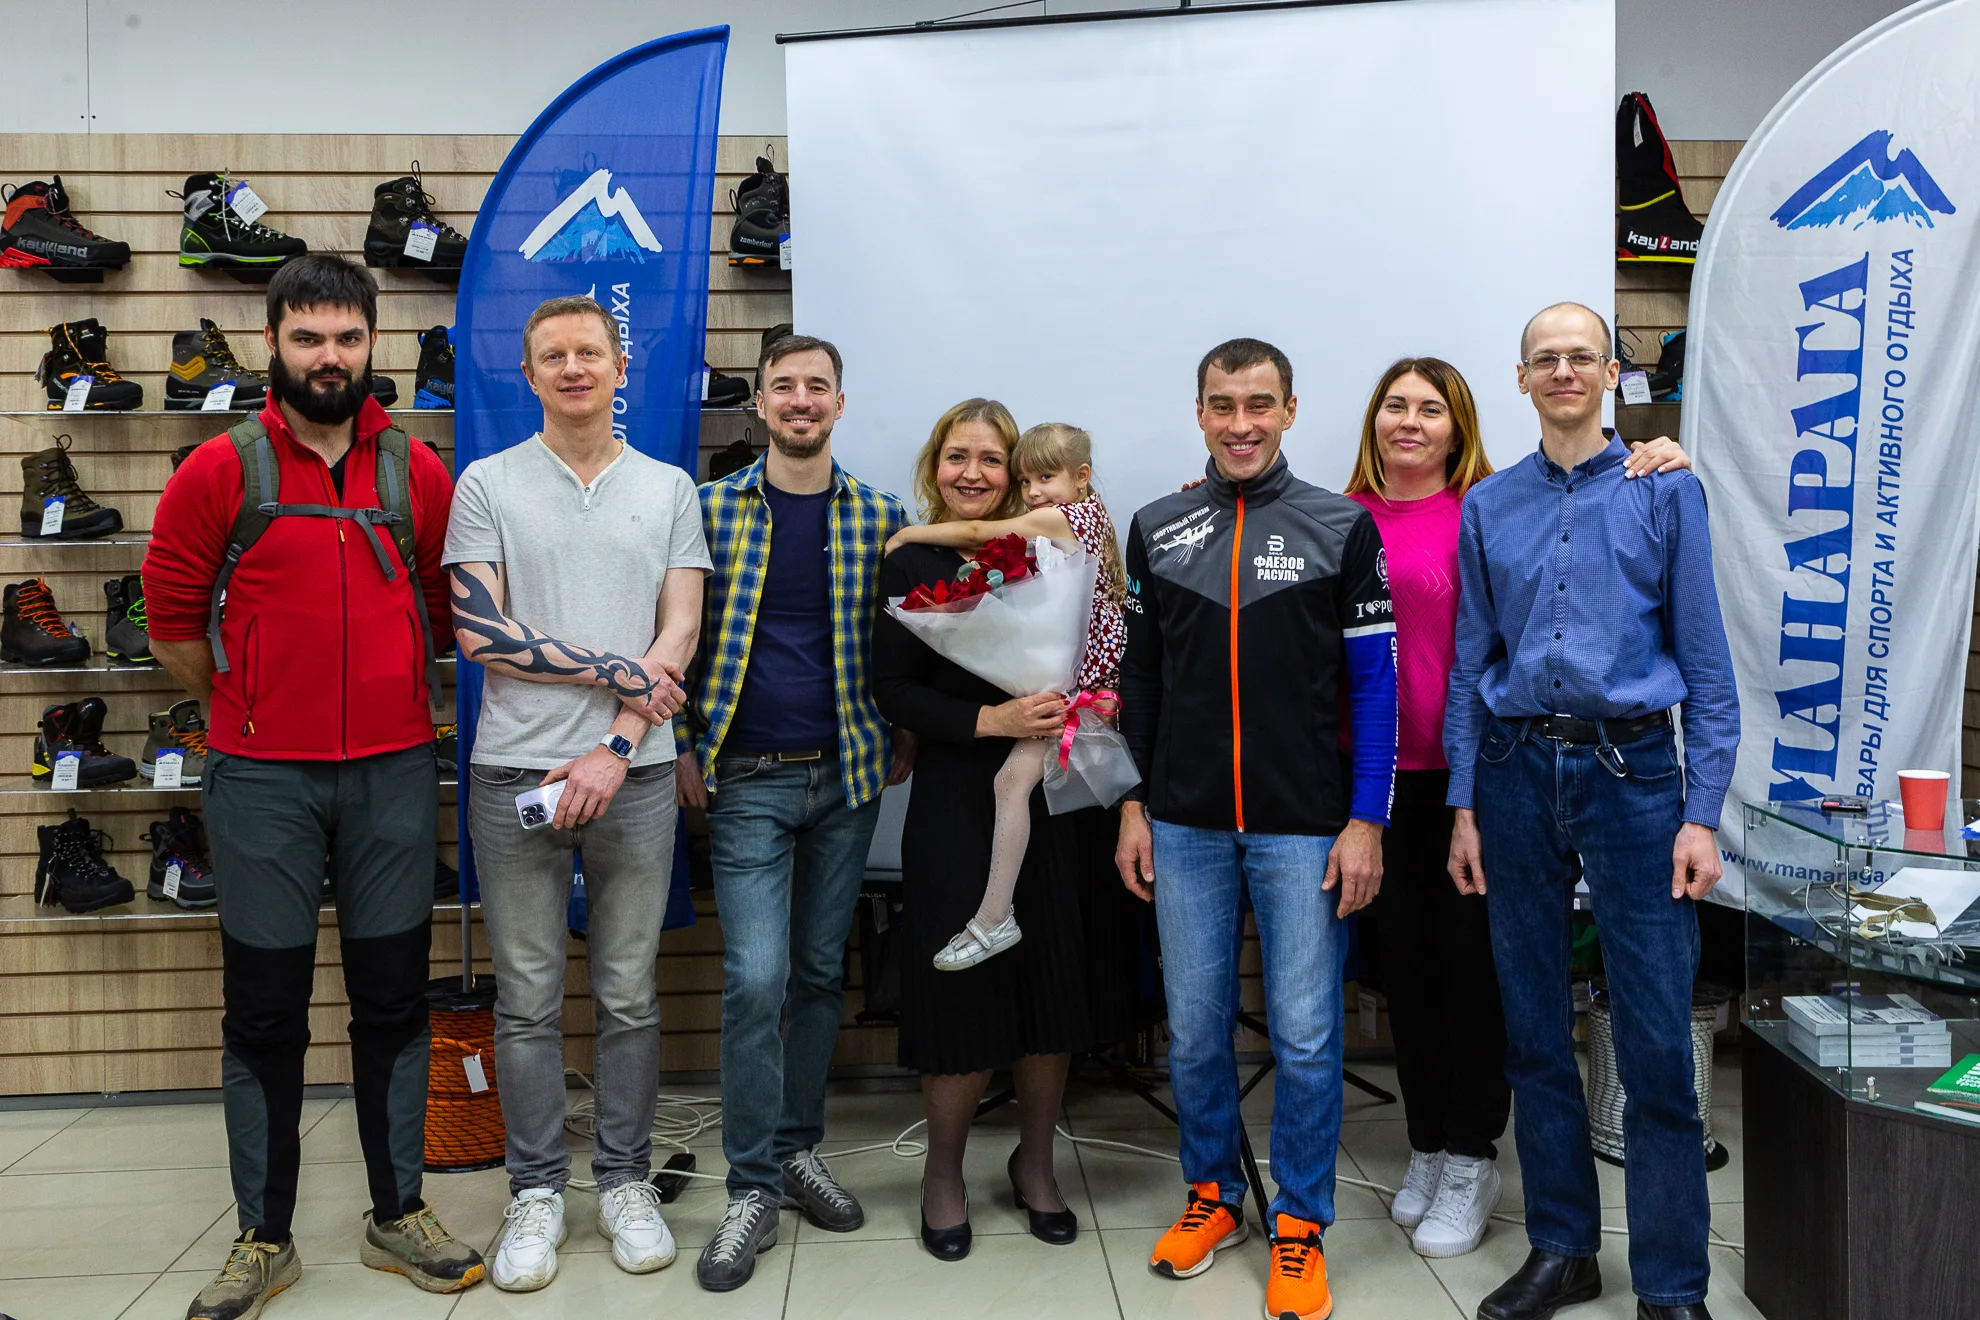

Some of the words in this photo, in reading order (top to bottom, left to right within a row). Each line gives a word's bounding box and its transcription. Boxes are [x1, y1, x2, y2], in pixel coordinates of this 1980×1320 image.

[1886, 248, 1915, 362] ОТДЫХА
[1876, 369, 1906, 528] АКТИВНОГО
[1152, 517, 1190, 541] СПОРТИВНЫЙ
[1187, 506, 1210, 522] ТУРИЗМ
[1875, 529, 1896, 552] И
[1253, 555, 1305, 571] ФАЕЗОВ
[1257, 568, 1299, 581] РАСУЛЬ
[1868, 559, 1895, 659] СПОРТА
[1864, 665, 1890, 722] ДЛЯ
[1855, 723, 1883, 801] ВАРЫ
